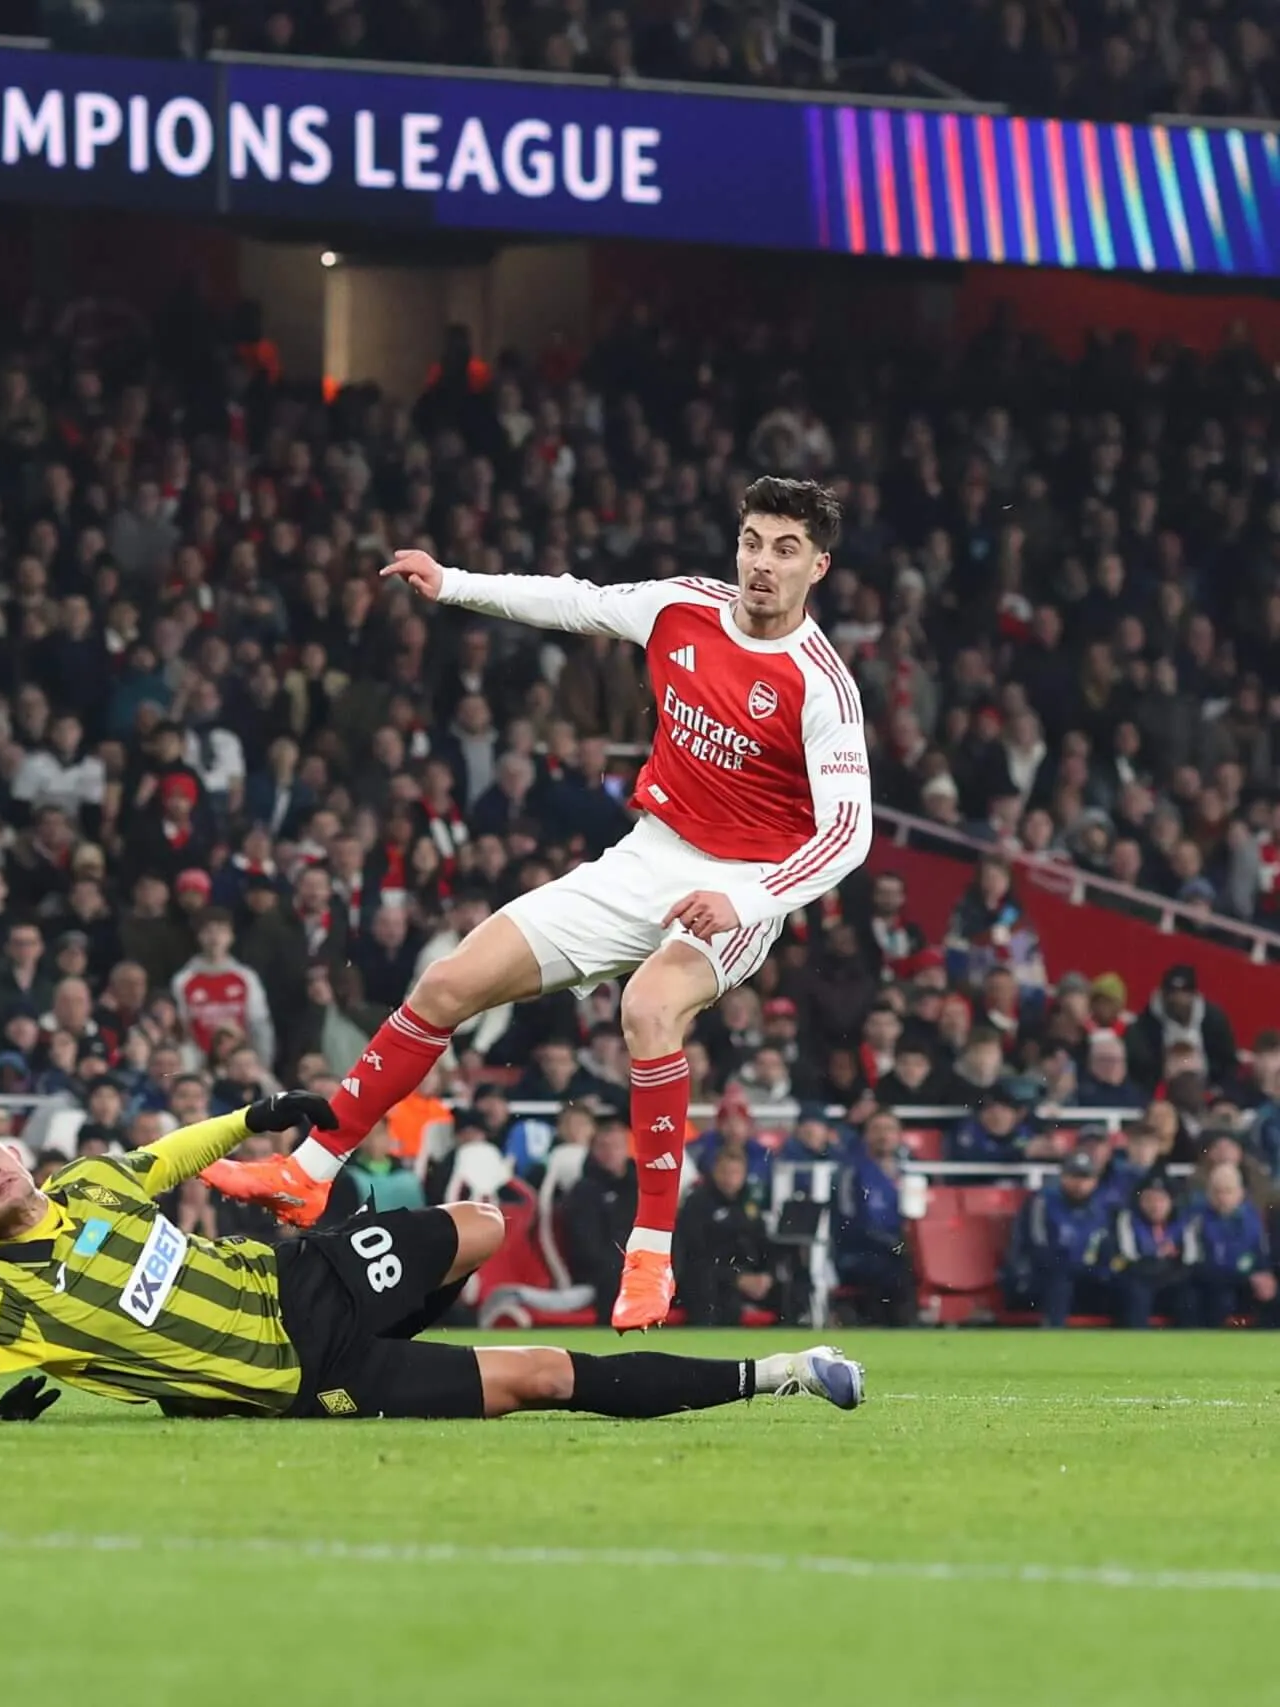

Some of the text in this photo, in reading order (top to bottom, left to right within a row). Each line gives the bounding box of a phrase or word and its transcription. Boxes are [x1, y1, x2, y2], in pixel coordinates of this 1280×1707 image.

[355, 109, 662, 204] LEAGUE
[663, 683, 762, 757] Emirates
[820, 763, 870, 778] RWAND
[832, 751, 862, 763] VISIT
[130, 1222, 180, 1315] 1XBET
[350, 1226, 403, 1293] 80
